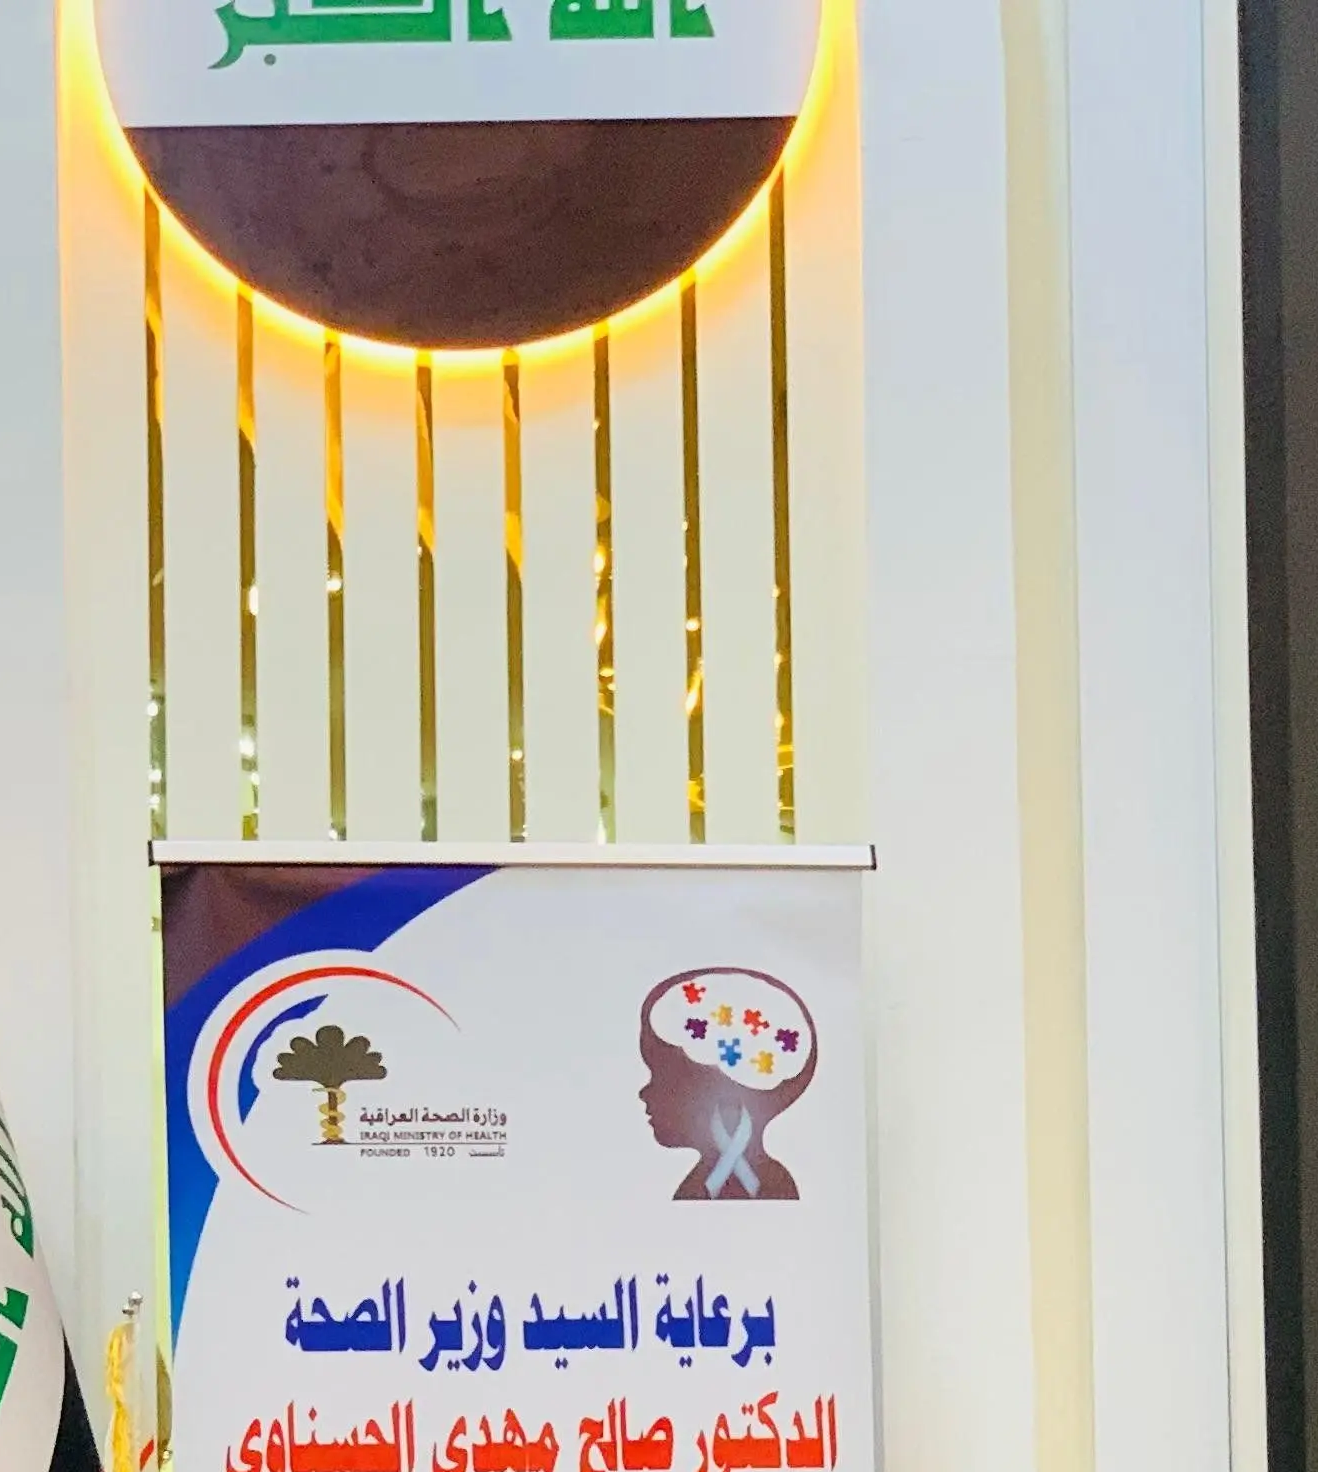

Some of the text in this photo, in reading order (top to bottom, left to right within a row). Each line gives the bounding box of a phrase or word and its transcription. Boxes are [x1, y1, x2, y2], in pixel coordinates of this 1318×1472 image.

[360, 1107, 507, 1126] وزارة الصحة العراقية
[360, 1131, 506, 1142] IRAQI MINISTRY OF HEALTH
[424, 1146, 455, 1157] 1920
[285, 1273, 775, 1372] برعاية السيد وزير الصحة
